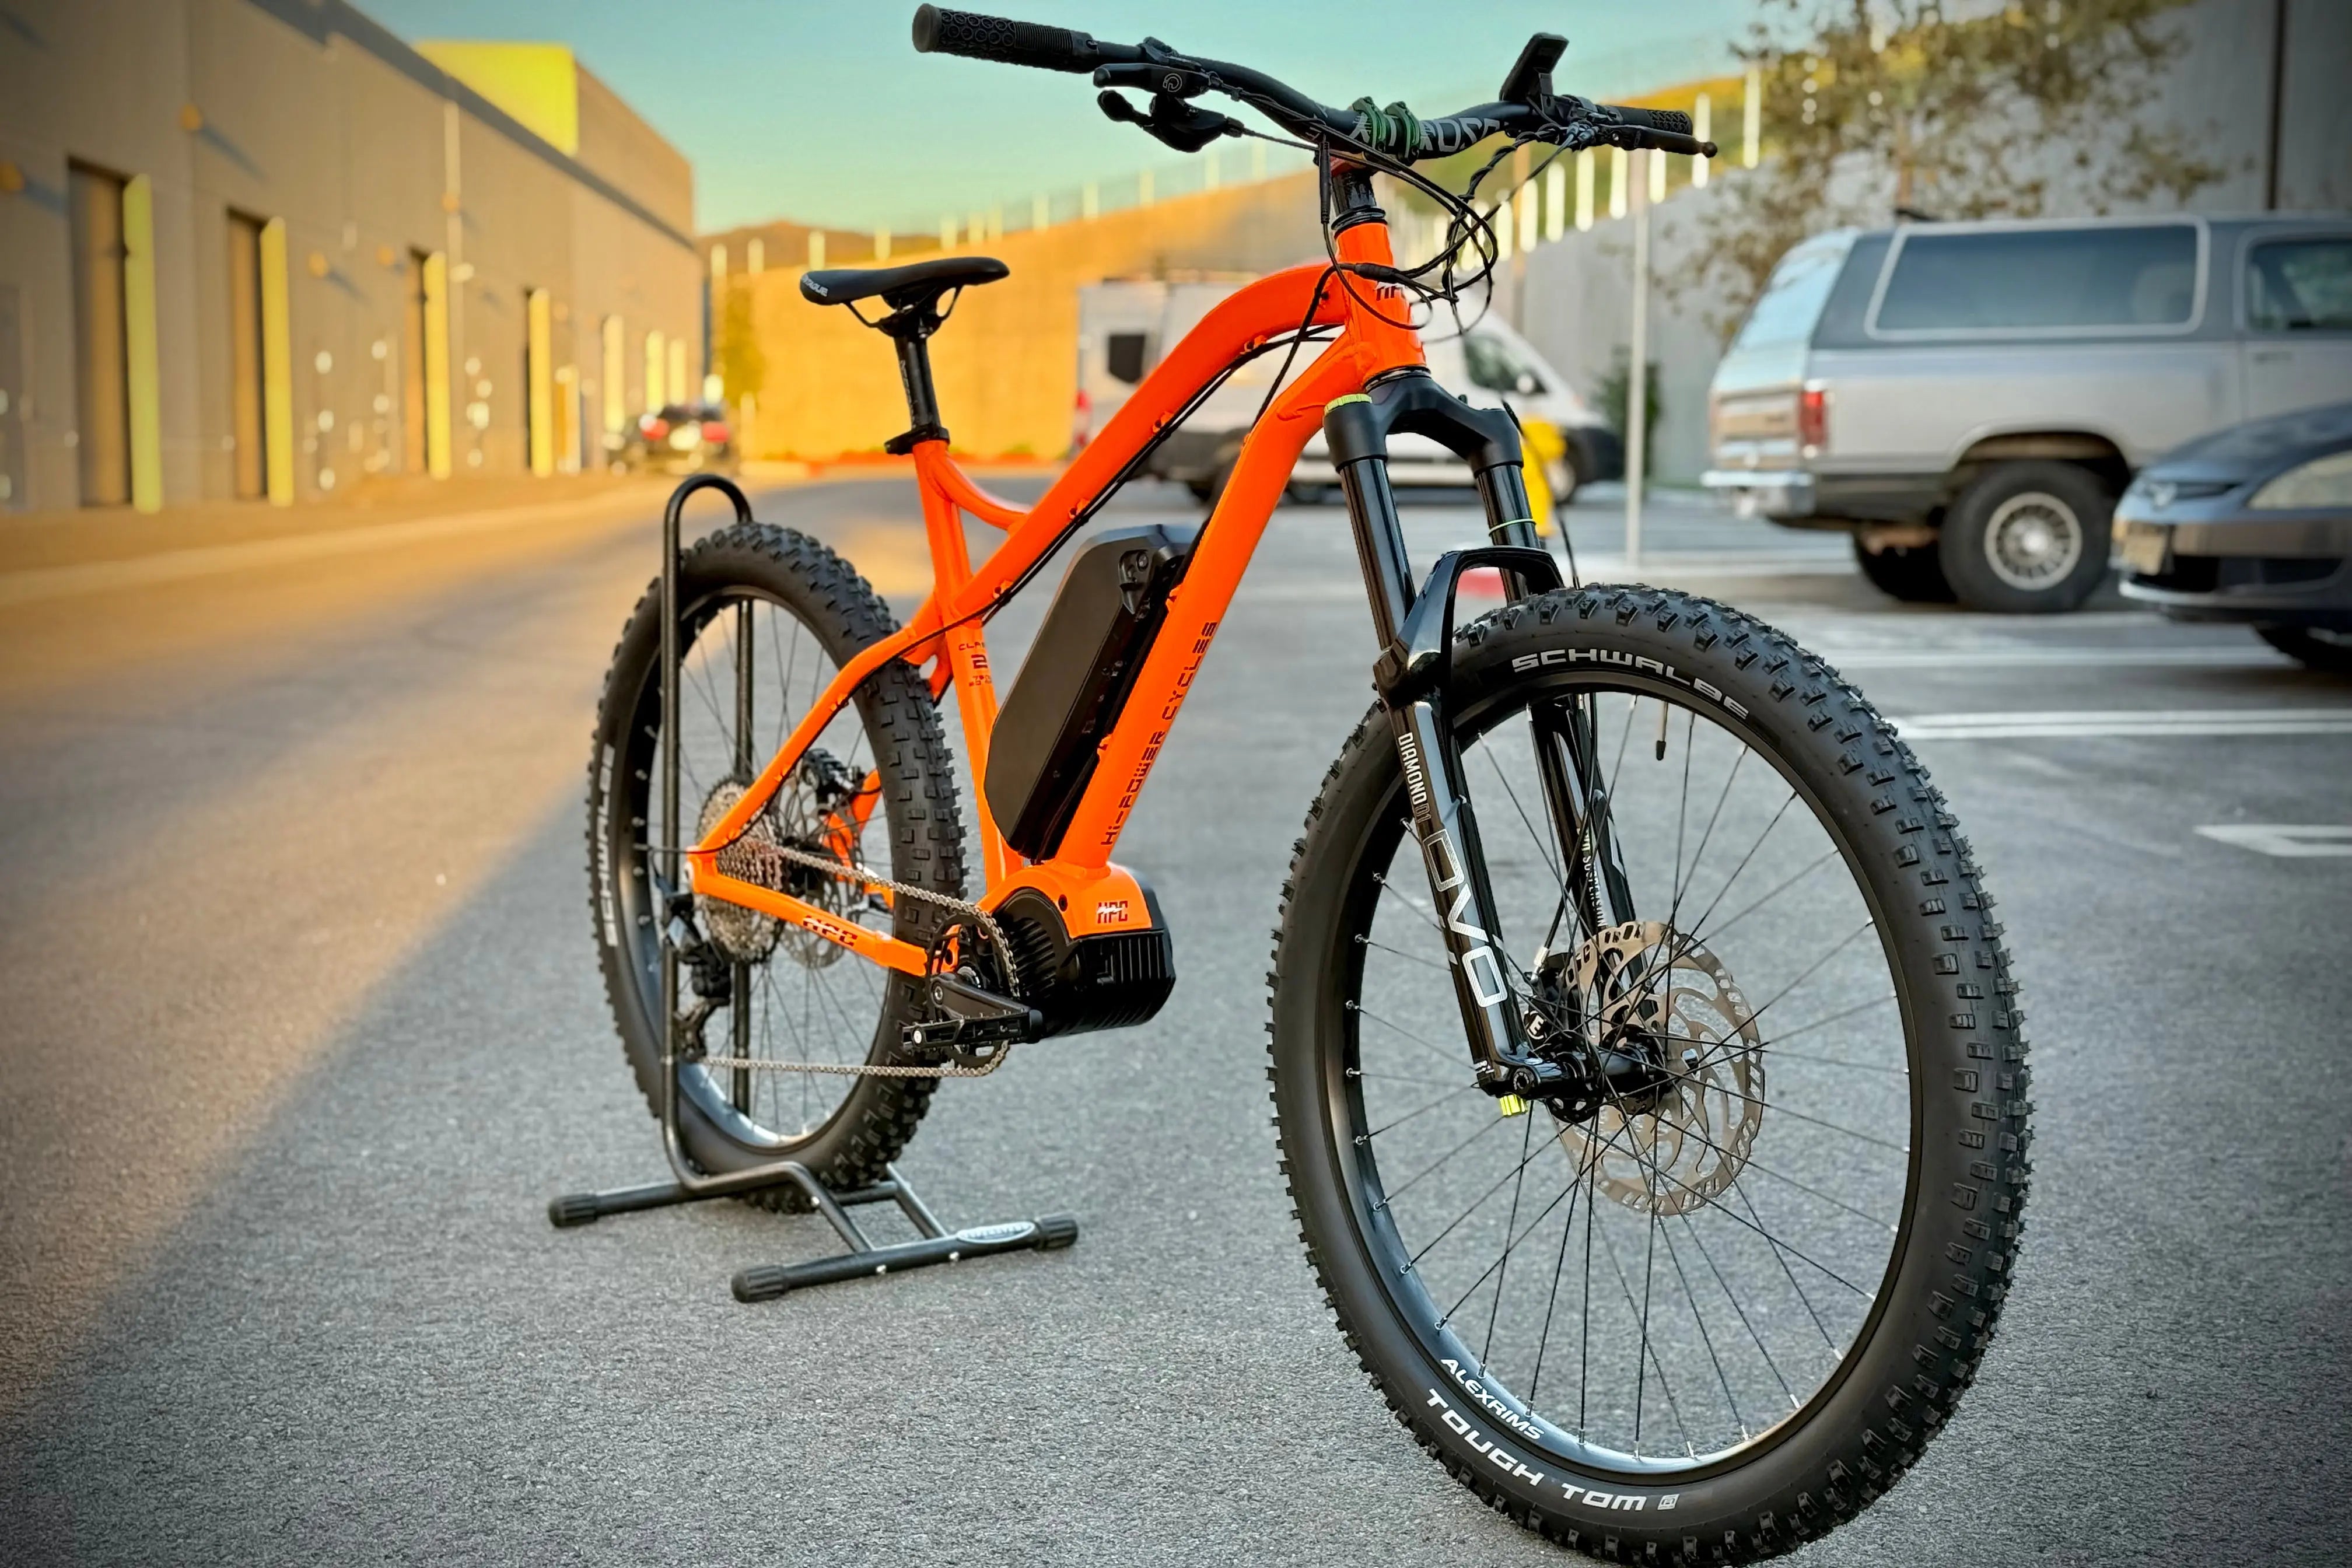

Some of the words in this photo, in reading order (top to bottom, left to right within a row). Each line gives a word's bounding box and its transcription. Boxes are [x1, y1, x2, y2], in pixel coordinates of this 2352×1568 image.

[1162, 622, 1217, 720] CYCLES
[1512, 648, 1749, 720] SCHWALBE
[1398, 732, 1427, 804] DIAMOND
[597, 743, 618, 947] SCHWALBE
[1441, 1359, 1545, 1440] ALEXRIMS
[1427, 1388, 1545, 1486] TOUGH
[1562, 1483, 1647, 1511] TOM
